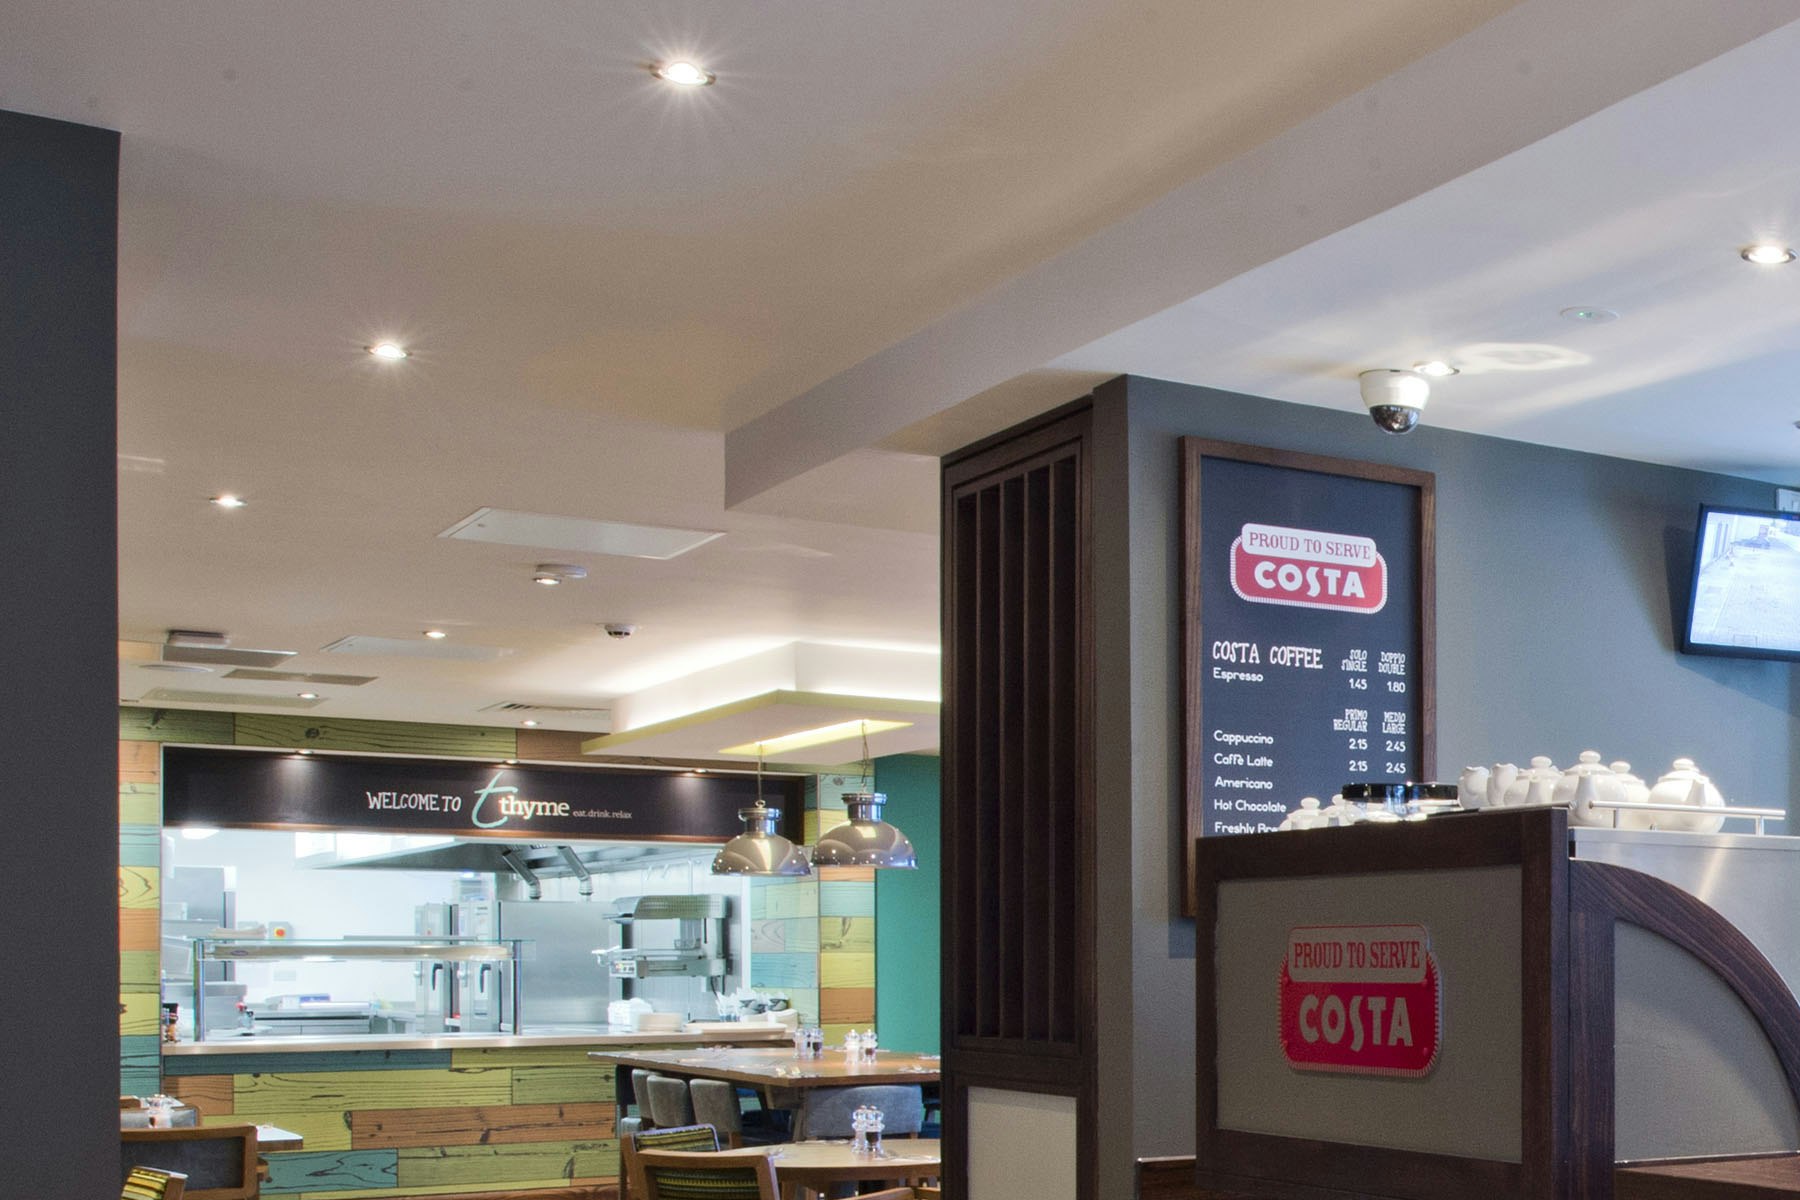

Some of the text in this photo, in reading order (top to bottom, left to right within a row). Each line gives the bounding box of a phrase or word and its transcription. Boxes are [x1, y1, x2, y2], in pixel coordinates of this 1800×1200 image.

[1249, 532, 1371, 560] PROUD TO SERVE
[1254, 560, 1366, 599] COSTA
[1212, 641, 1324, 670] COSTA COFFEE
[1213, 667, 1264, 683] Espresso
[1341, 659, 1406, 676] SINGLE DOUBLE
[1345, 708, 1368, 721] PRIMO
[1333, 719, 1406, 735] REGULAR LARGE
[1213, 730, 1406, 752] Cappuccino 2.15 2.45
[1214, 753, 1406, 774] Caffè Latte 2.15 2.45
[1215, 776, 1273, 790] Americano
[366, 791, 439, 811] WELCOME
[442, 795, 462, 812] TO
[499, 795, 570, 820] thyme
[1214, 800, 1287, 813] Hot Chocolate
[1294, 940, 1420, 968] PROUD TO SERVE
[1300, 994, 1414, 1053] COSTA
